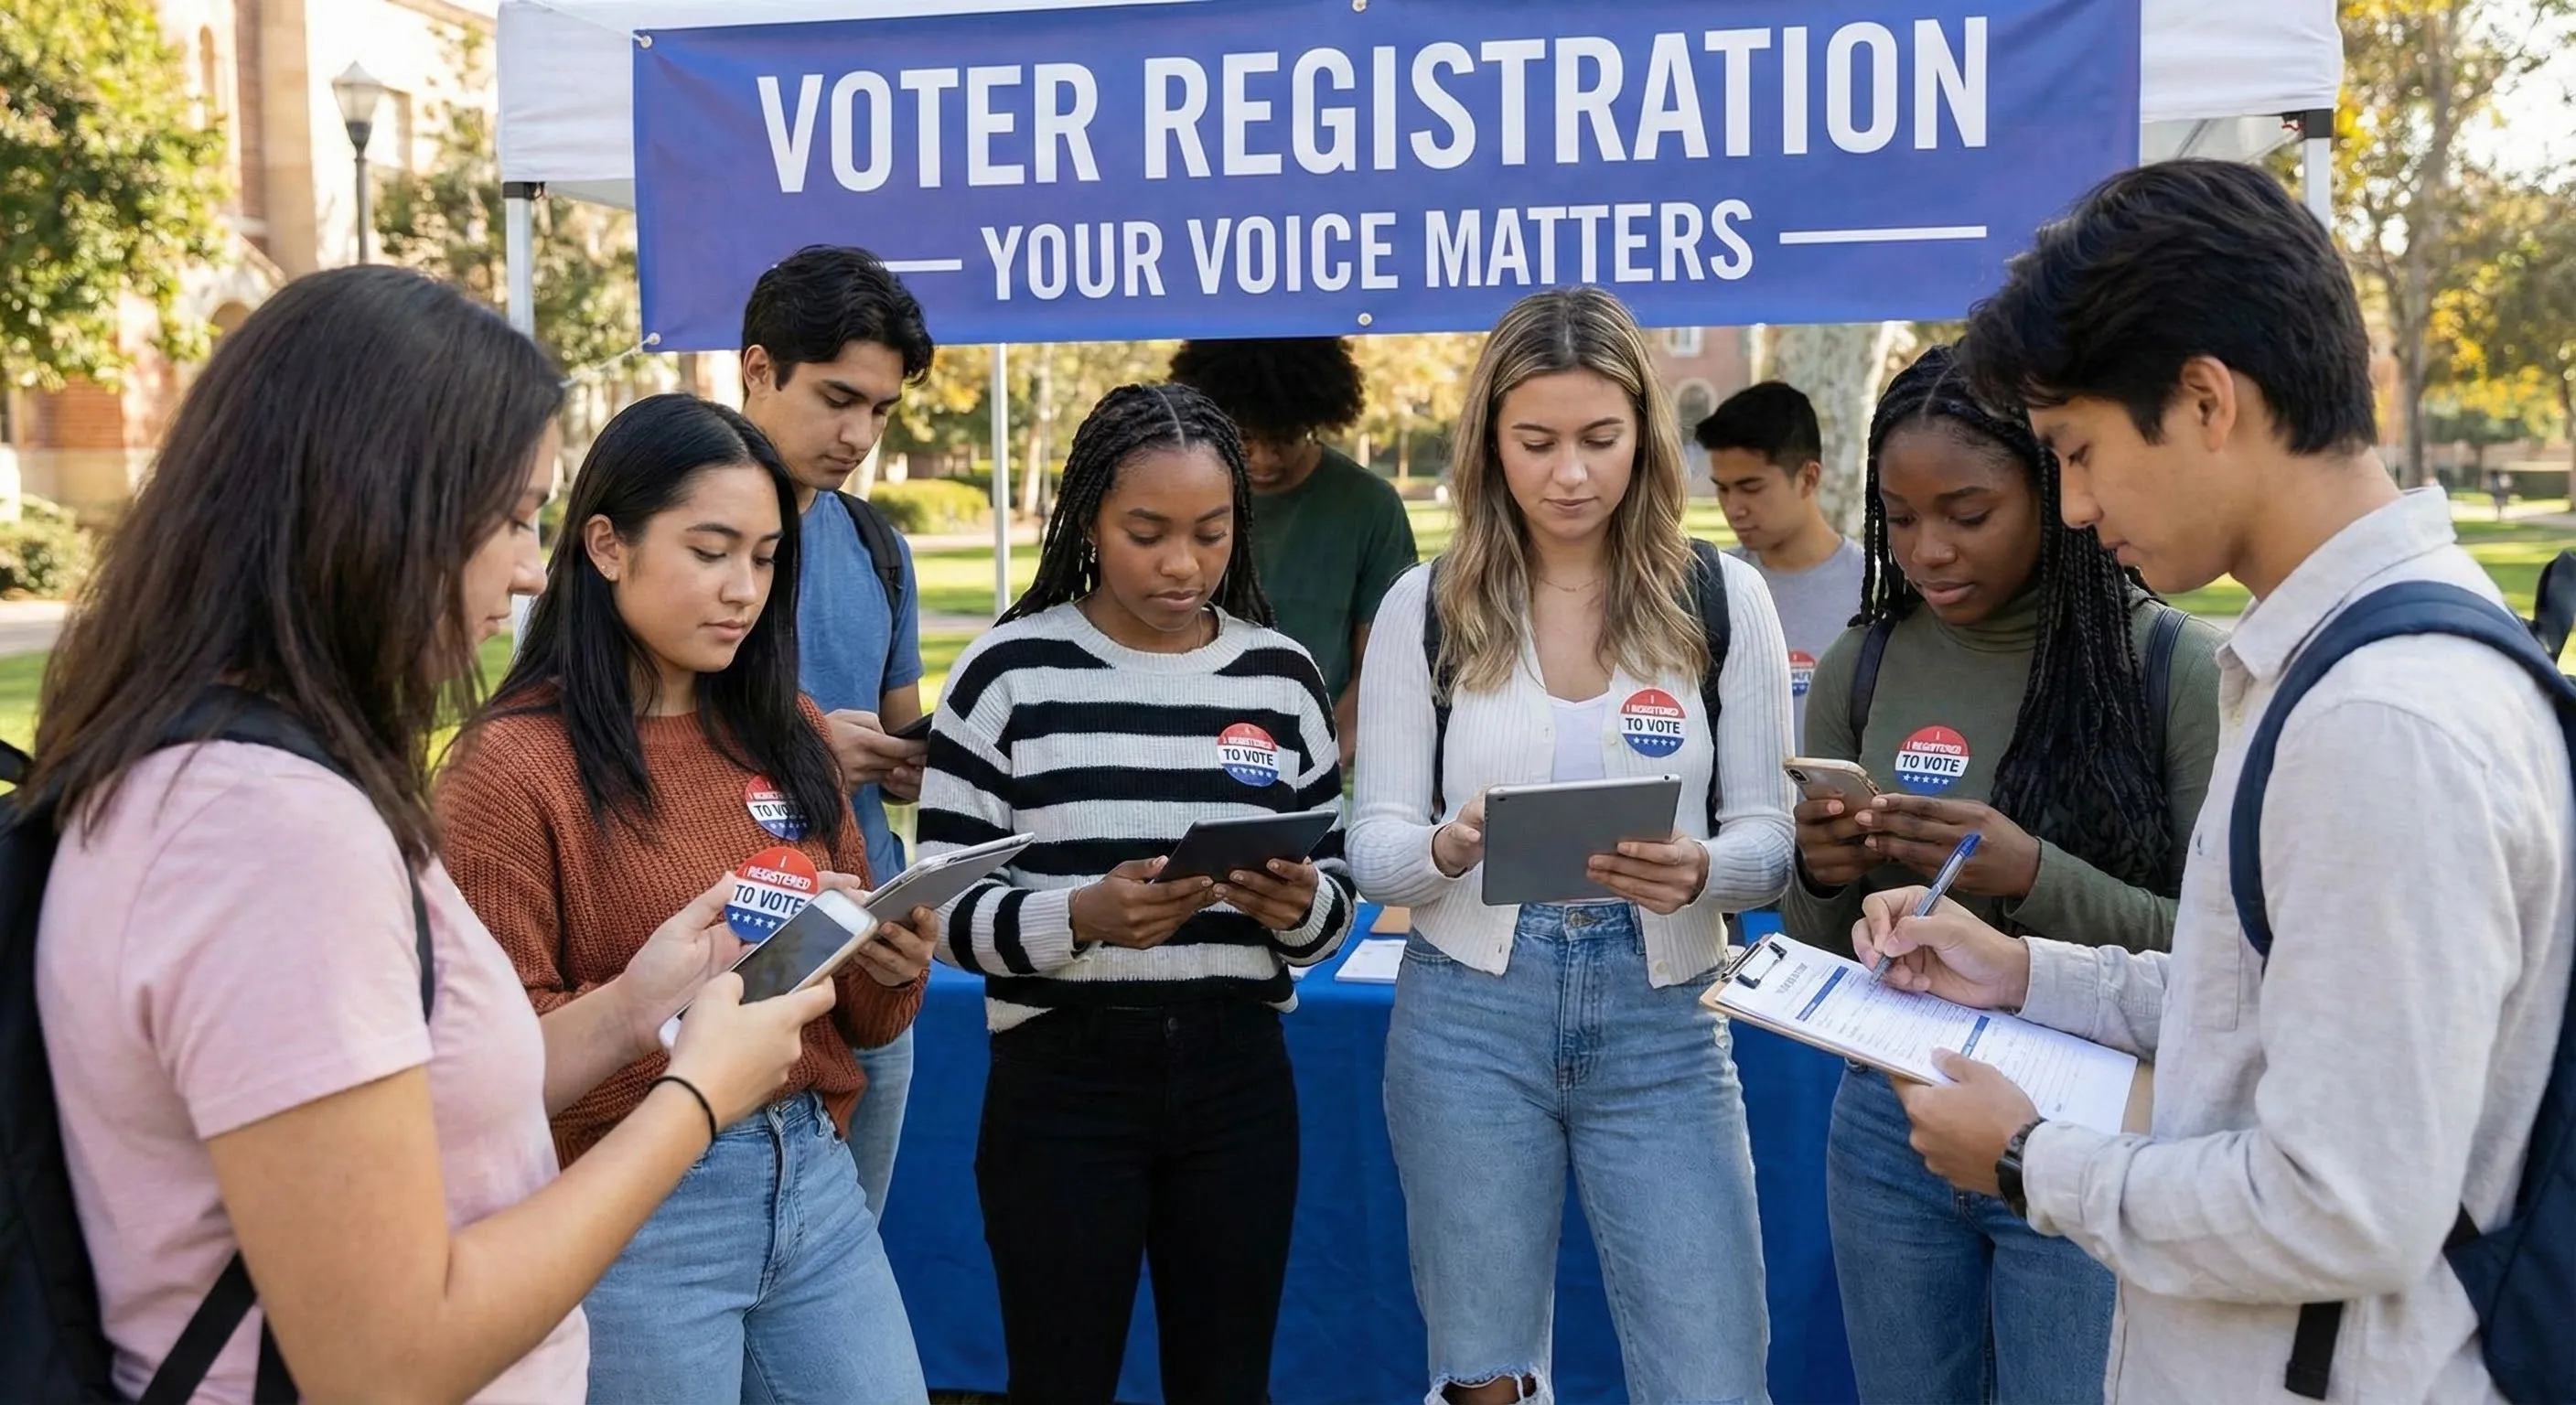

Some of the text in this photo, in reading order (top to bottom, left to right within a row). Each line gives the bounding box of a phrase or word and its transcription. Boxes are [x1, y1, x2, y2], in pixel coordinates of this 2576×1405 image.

[757, 16, 1987, 193] VOTER REGISTRATION
[981, 198, 1754, 301] YOUR VOICE MATTERS
[1626, 718, 1680, 735] TO VOTE
[1223, 748, 1274, 766] TO VOTE
[1903, 755, 1960, 773] TO VOTE
[754, 804, 773, 817] TO
[734, 885, 805, 916] TO VOTE
